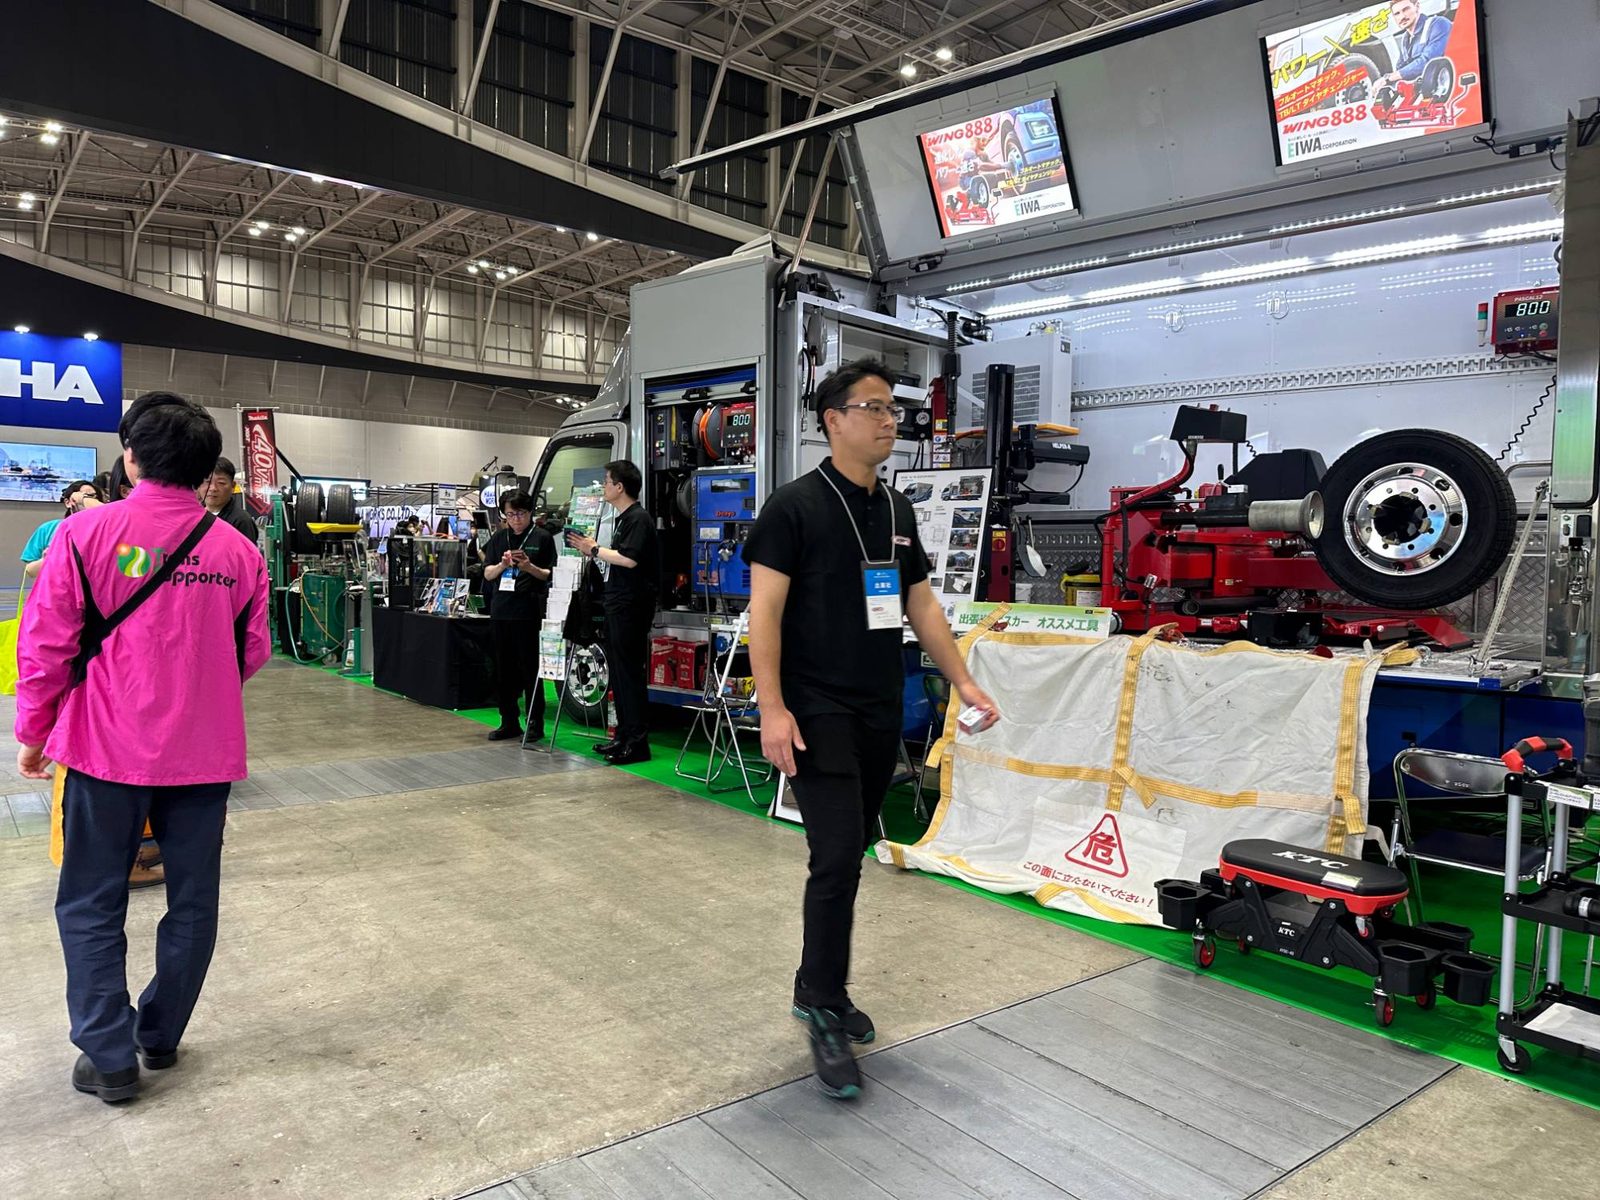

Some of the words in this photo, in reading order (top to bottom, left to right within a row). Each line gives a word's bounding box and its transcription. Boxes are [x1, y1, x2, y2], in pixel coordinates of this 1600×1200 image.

[1282, 104, 1367, 135] WING888
[928, 117, 993, 147] WING888
[1287, 137, 1322, 159] EIWA
[1322, 138, 1358, 150] CORPORATION
[1014, 199, 1041, 217] EIWA
[1516, 301, 1551, 317] 800
[732, 414, 751, 426] 800
[1037, 616, 1099, 632] オススメ工具
[1081, 831, 1118, 866] 危
[1271, 850, 1349, 870] KTC
[1277, 927, 1296, 937] KTC
